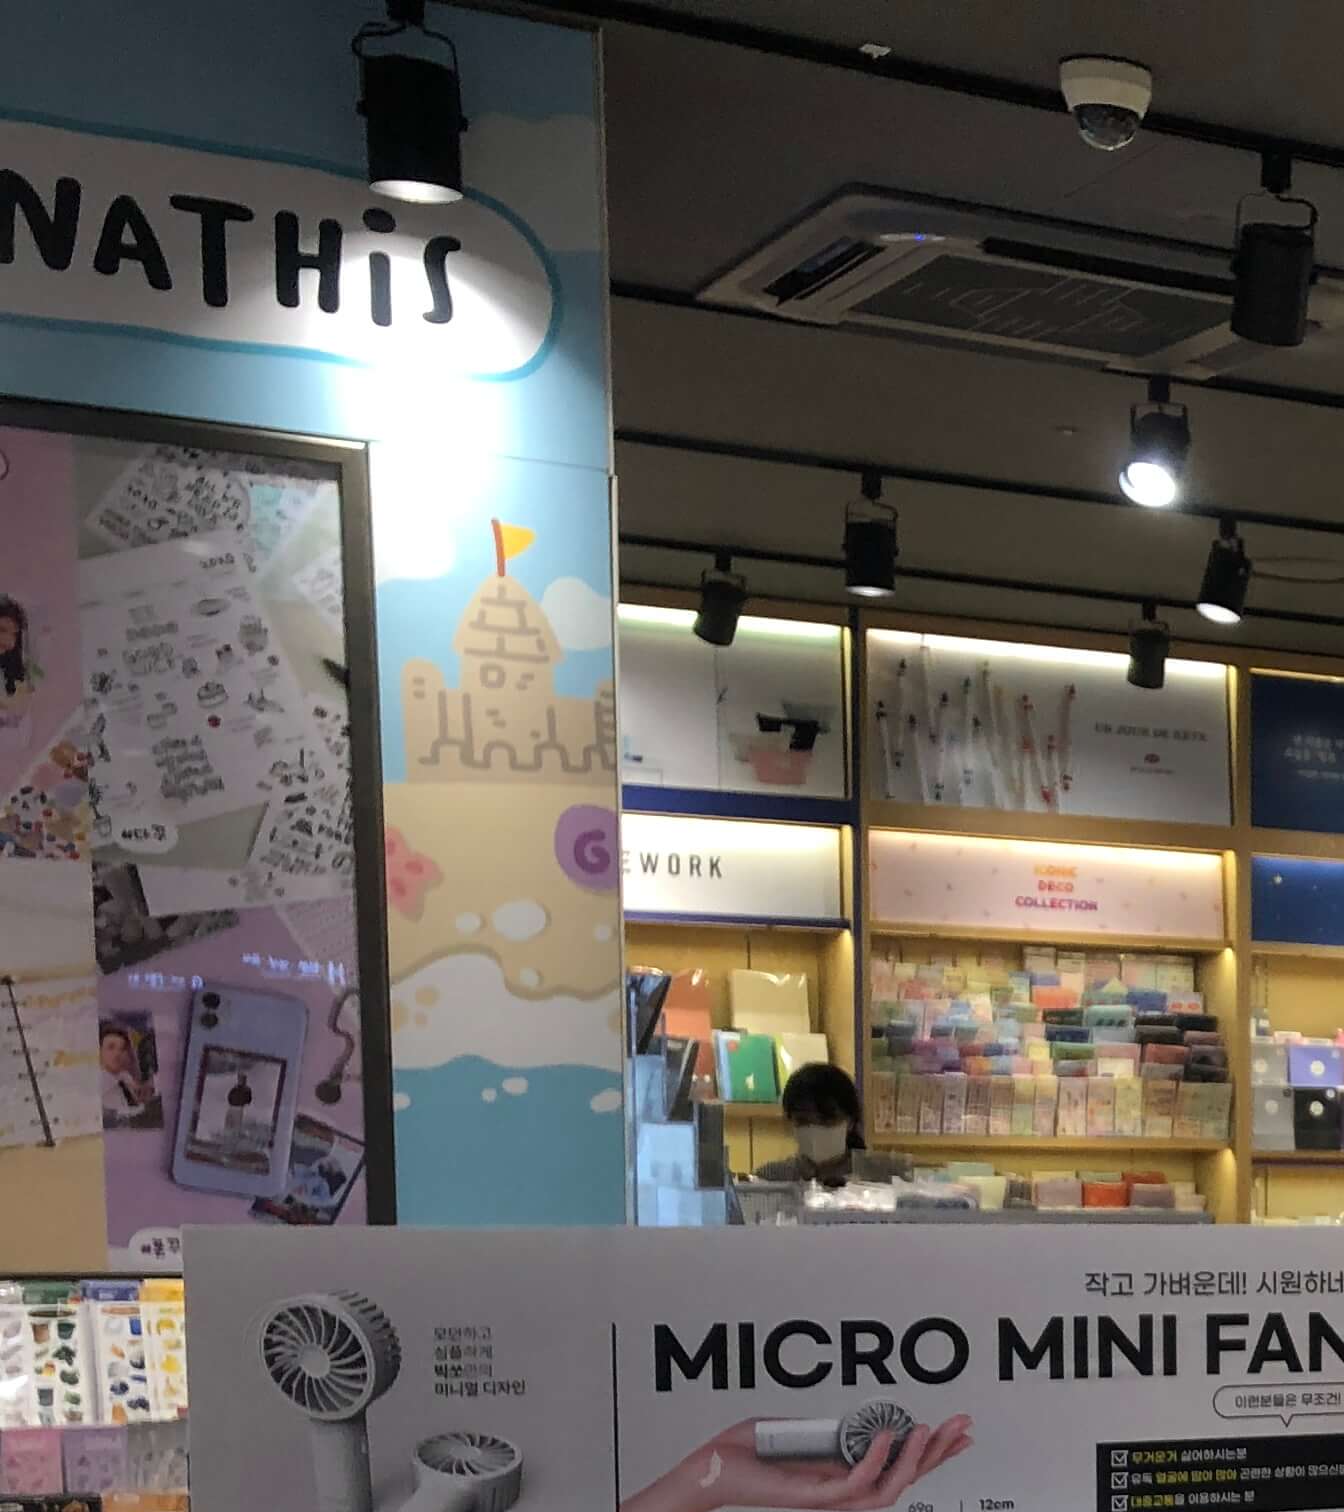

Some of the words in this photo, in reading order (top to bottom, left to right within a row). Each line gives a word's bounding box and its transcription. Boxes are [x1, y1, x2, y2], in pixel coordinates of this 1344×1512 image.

[1014, 895, 1099, 912] COLLECTION
[1085, 1272, 1135, 1297] 작고
[1143, 1270, 1248, 1297] 가벼운데!
[653, 1316, 970, 1392] MICRO
[997, 1312, 1178, 1382] MINI
[434, 1381, 479, 1398] 미니멀
[483, 1378, 527, 1396] 디자인
[1234, 1393, 1297, 1410] 이런분들은
[1301, 1391, 1342, 1408] 무조건!
[979, 1497, 1015, 1512] 12cm
